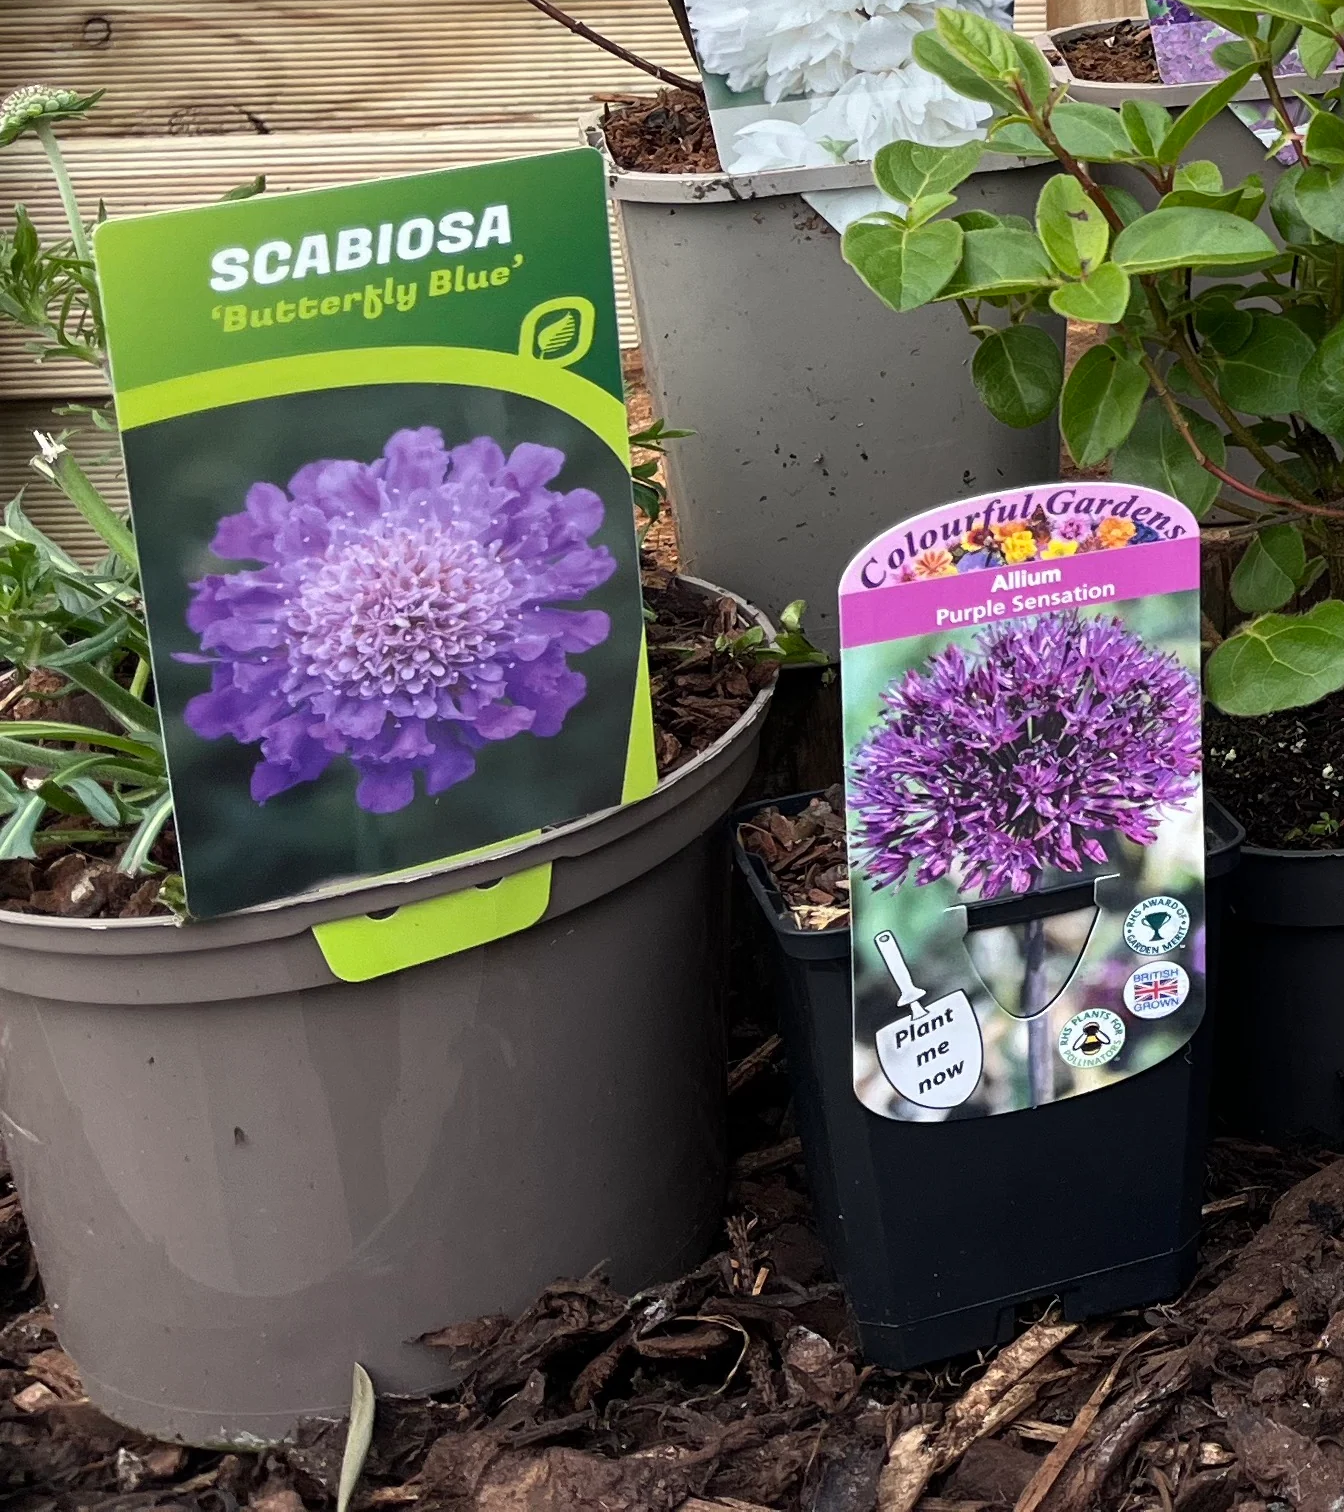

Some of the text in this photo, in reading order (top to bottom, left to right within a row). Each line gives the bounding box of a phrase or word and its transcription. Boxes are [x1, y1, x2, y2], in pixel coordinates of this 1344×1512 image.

[209, 204, 512, 293] SCABIOSA
[860, 489, 1186, 589] Colourful Gardens
[991, 565, 1062, 593] Allium
[936, 583, 1116, 626] Purple Sensation
[1126, 898, 1187, 928] RHS AWARD OF
[1127, 925, 1187, 954] GARDEN MERIT
[1133, 967, 1179, 983] BRITISH
[1134, 998, 1180, 1012] GROWN
[895, 1007, 955, 1050] Plant
[1060, 1010, 1123, 1046] RHS PLANTS FOR
[916, 1042, 950, 1068] me
[1063, 1039, 1122, 1066] POLLINATORS
[918, 1060, 965, 1095] now
